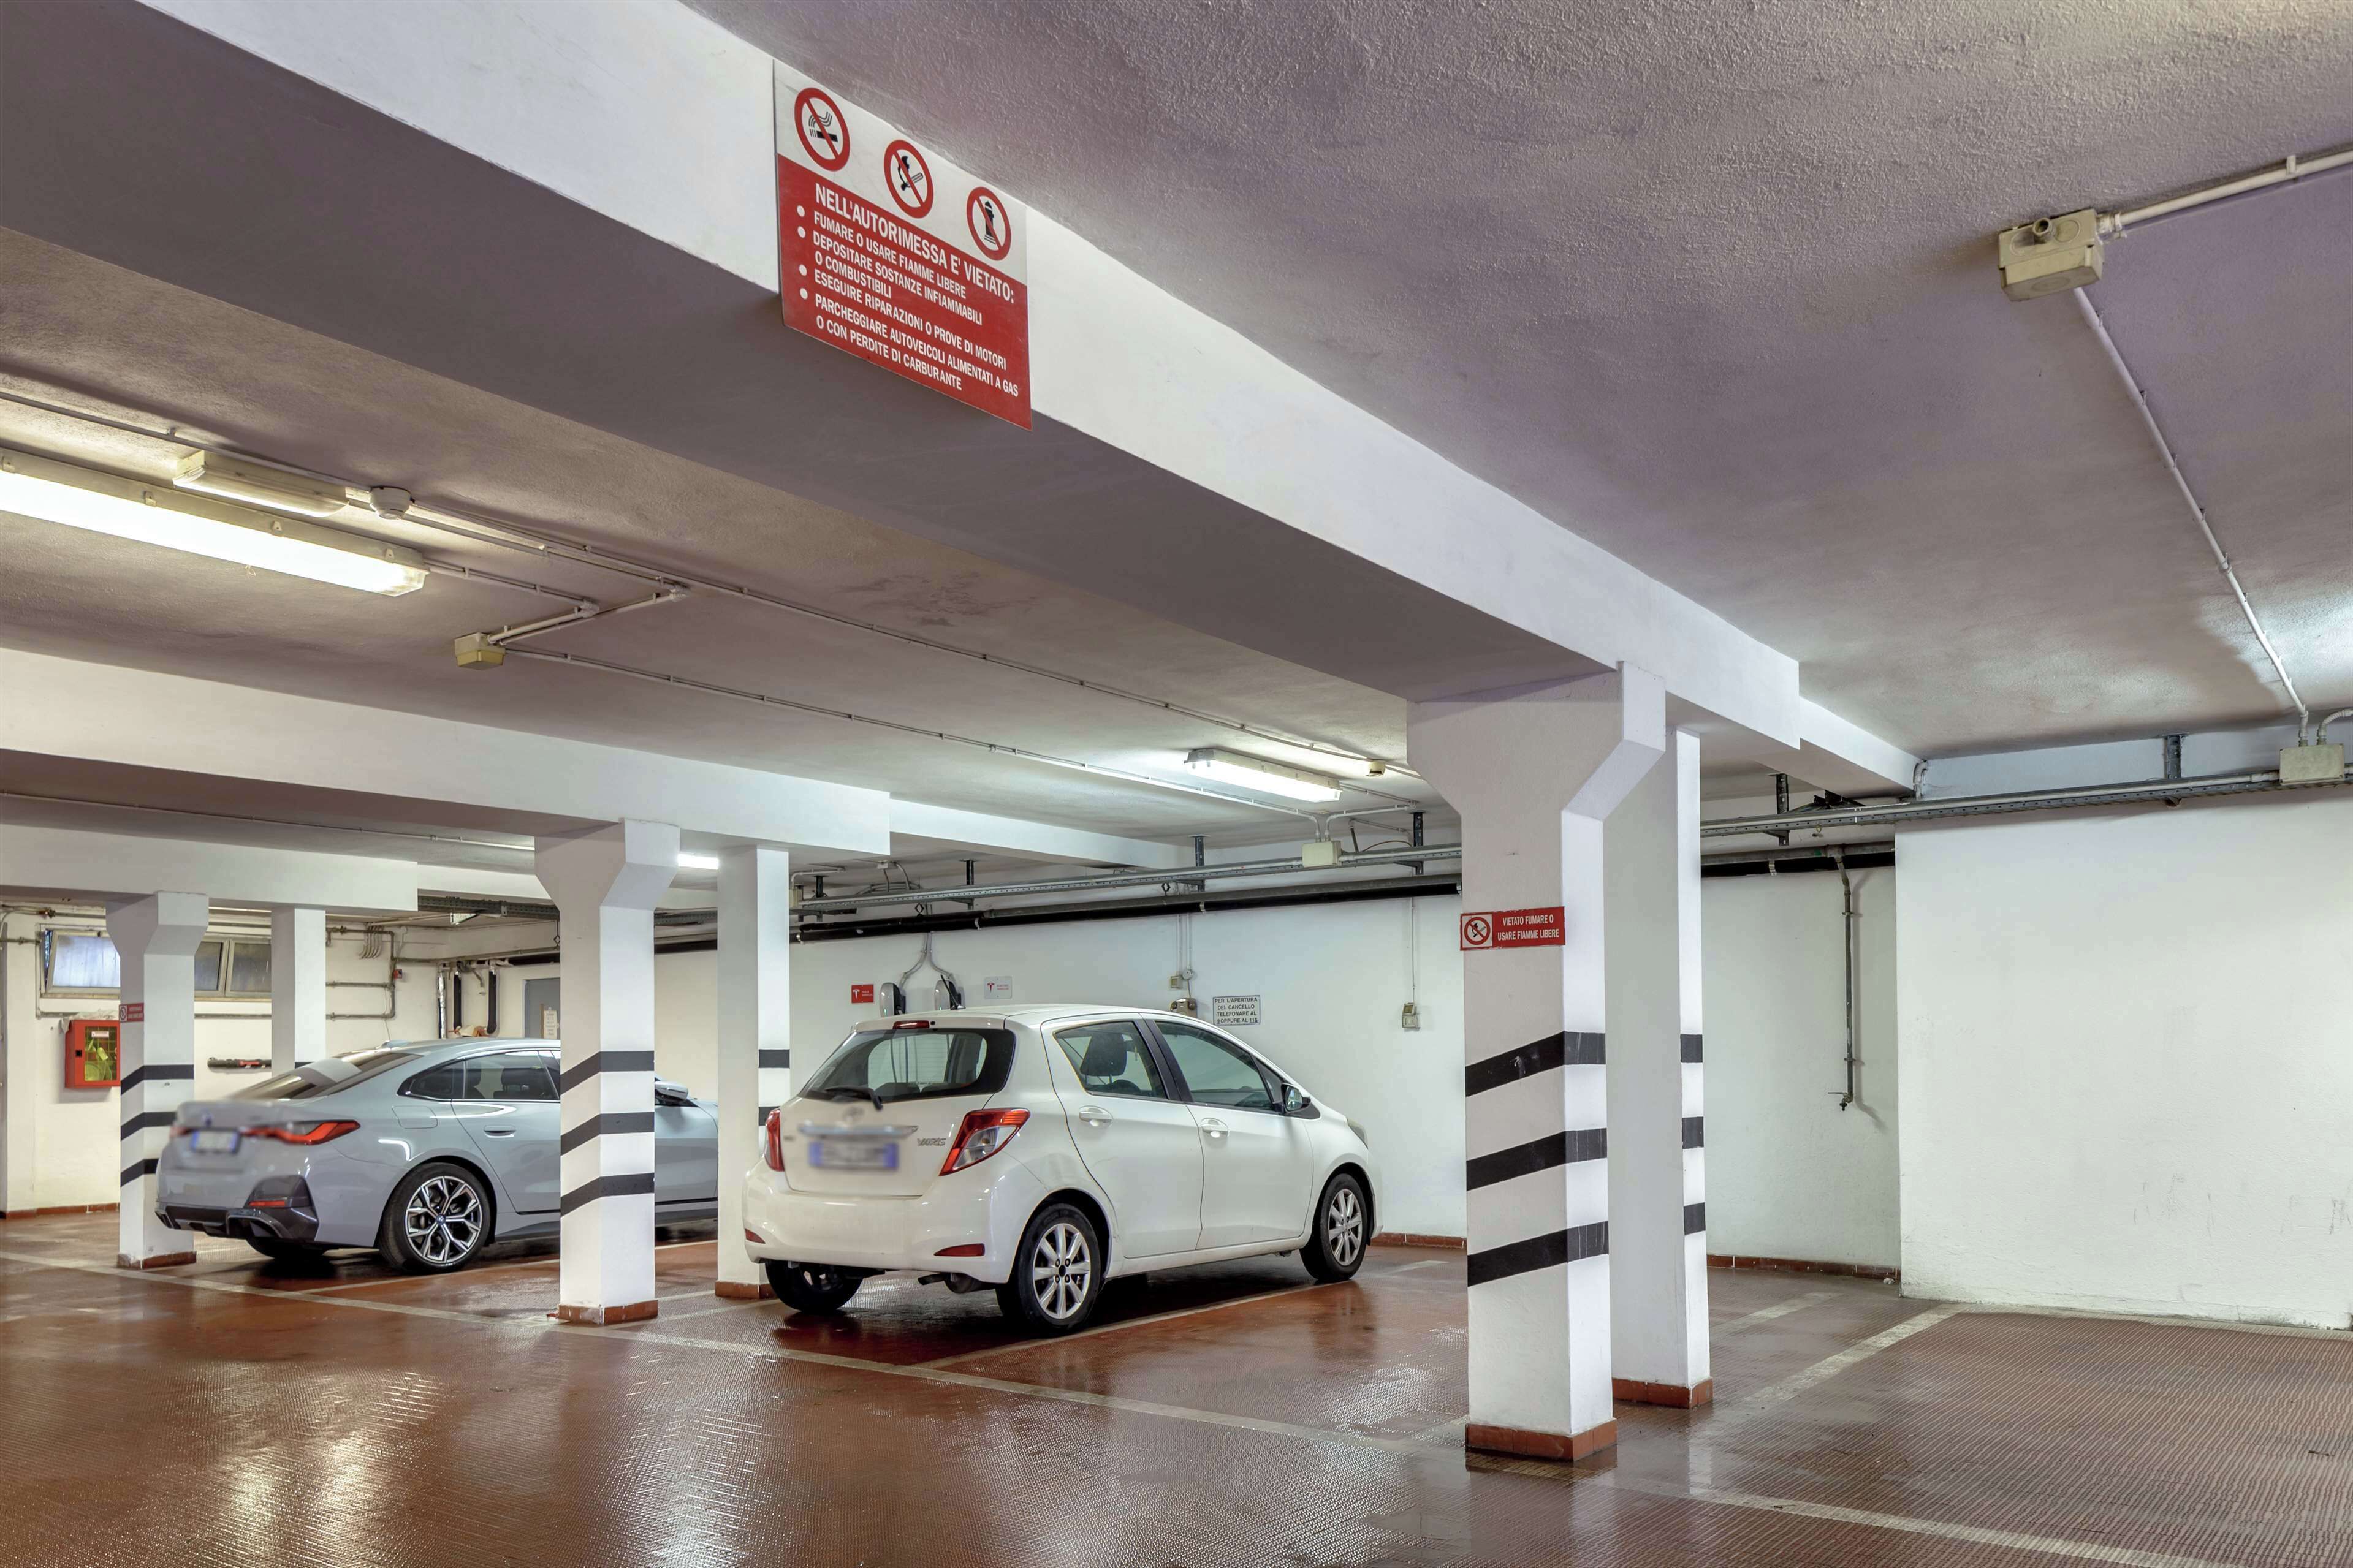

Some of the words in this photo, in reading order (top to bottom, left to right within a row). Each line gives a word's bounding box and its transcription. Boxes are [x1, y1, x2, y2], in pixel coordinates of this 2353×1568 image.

[813, 230, 873, 272] DEPOSITARE
[875, 262, 922, 297] SOSTANZE
[924, 286, 982, 326] INFIAMMABILI
[814, 210, 854, 243] FUMARE
[856, 233, 864, 248] O
[866, 237, 897, 265] USARE
[899, 254, 934, 284] FIAMME
[937, 273, 966, 299] LIBERE
[815, 183, 948, 269] NELL'AUTORIMESSA
[951, 254, 960, 275] E'
[964, 261, 1014, 304] VIETATO:
[815, 251, 823, 265] O
[825, 255, 891, 299] COMBUSTIBILI
[814, 268, 863, 304] ESEGUIRE
[865, 293, 923, 331] RIPARAZIONI
[925, 322, 932, 335] O
[933, 325, 962, 350] PROVE
[964, 339, 973, 355] DI
[975, 344, 1006, 371] MOTORI
[815, 293, 888, 339] PARCHEGGIARE
[890, 328, 946, 364] AUTOVEICOLI
[947, 354, 993, 386] ALIMENTATI
[995, 376, 1001, 390] A
[1003, 379, 1019, 398] GAS
[816, 315, 824, 330] O
[826, 319, 848, 341] CON
[850, 329, 889, 359] PERDITE
[891, 347, 901, 364] DI
[903, 354, 962, 391] CARBURANTE
[1497, 931, 1516, 941] USARE
[1517, 930, 1539, 940] FIAMME
[1540, 928, 1560, 939] LIBERE
[1502, 916, 1524, 926] VIETATO
[1525, 914, 1548, 925] FUMARE
[1549, 914, 1554, 923] O
